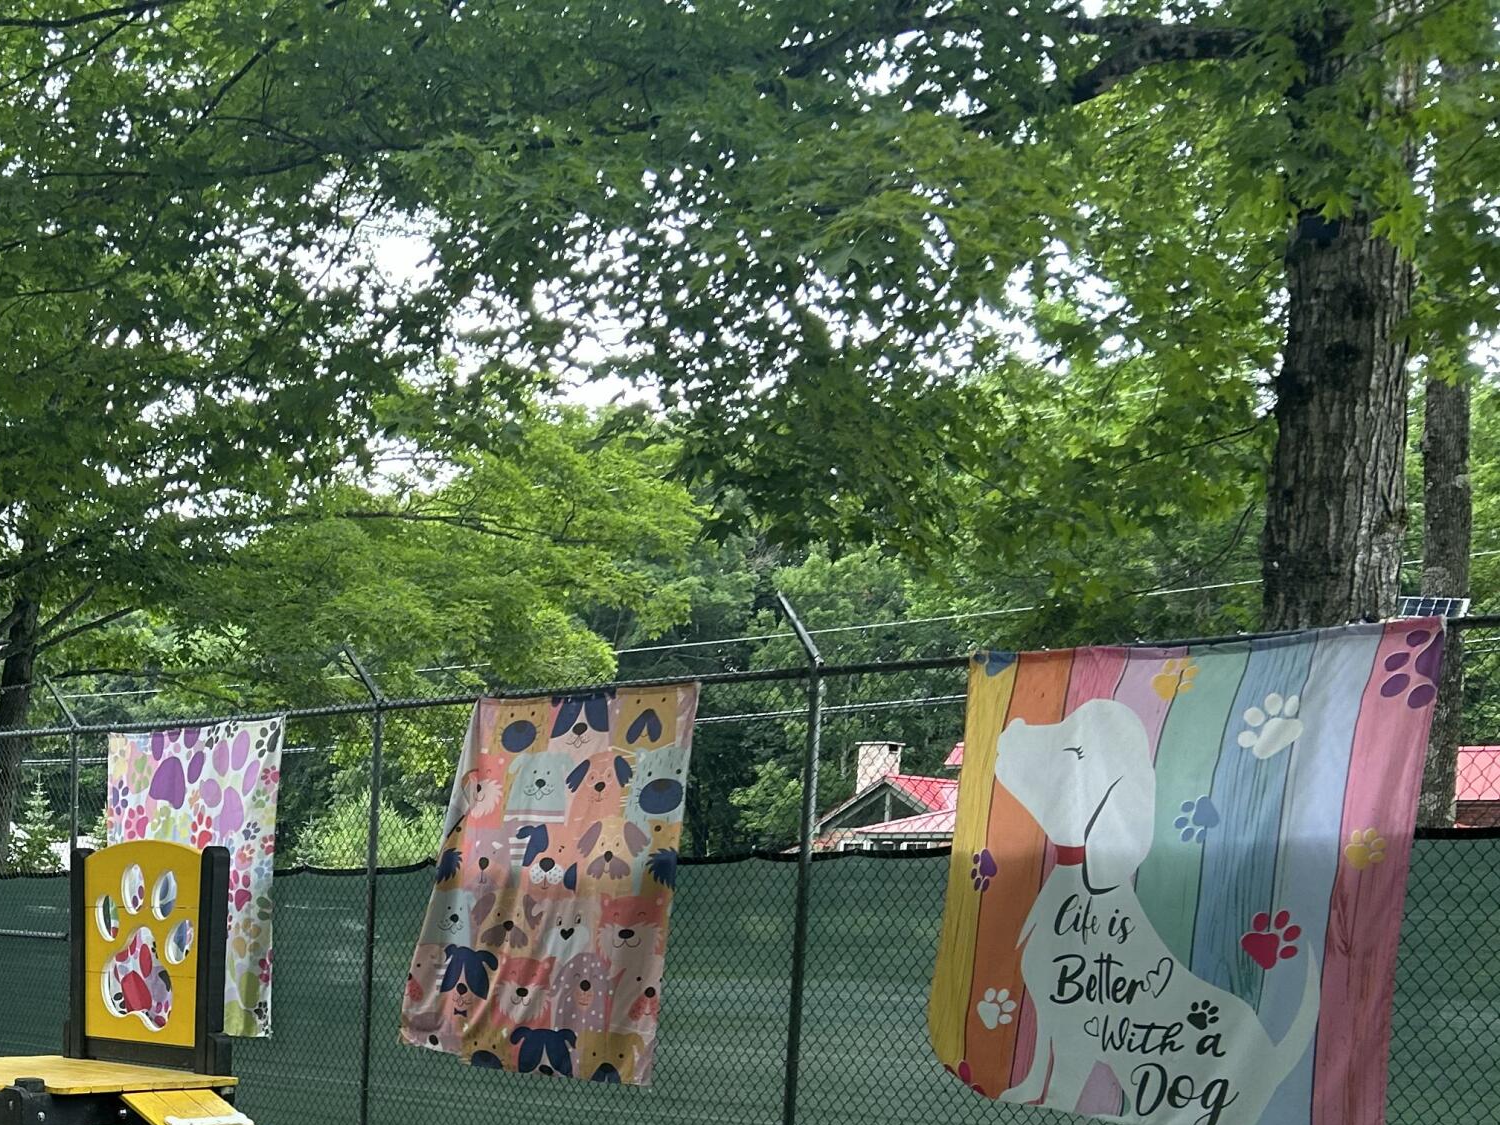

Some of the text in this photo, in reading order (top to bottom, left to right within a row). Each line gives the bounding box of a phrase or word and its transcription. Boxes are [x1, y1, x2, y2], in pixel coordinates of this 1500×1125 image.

[1054, 893, 1136, 944] Life is
[1049, 952, 1149, 1005] Better
[1101, 1015, 1226, 1057] With a
